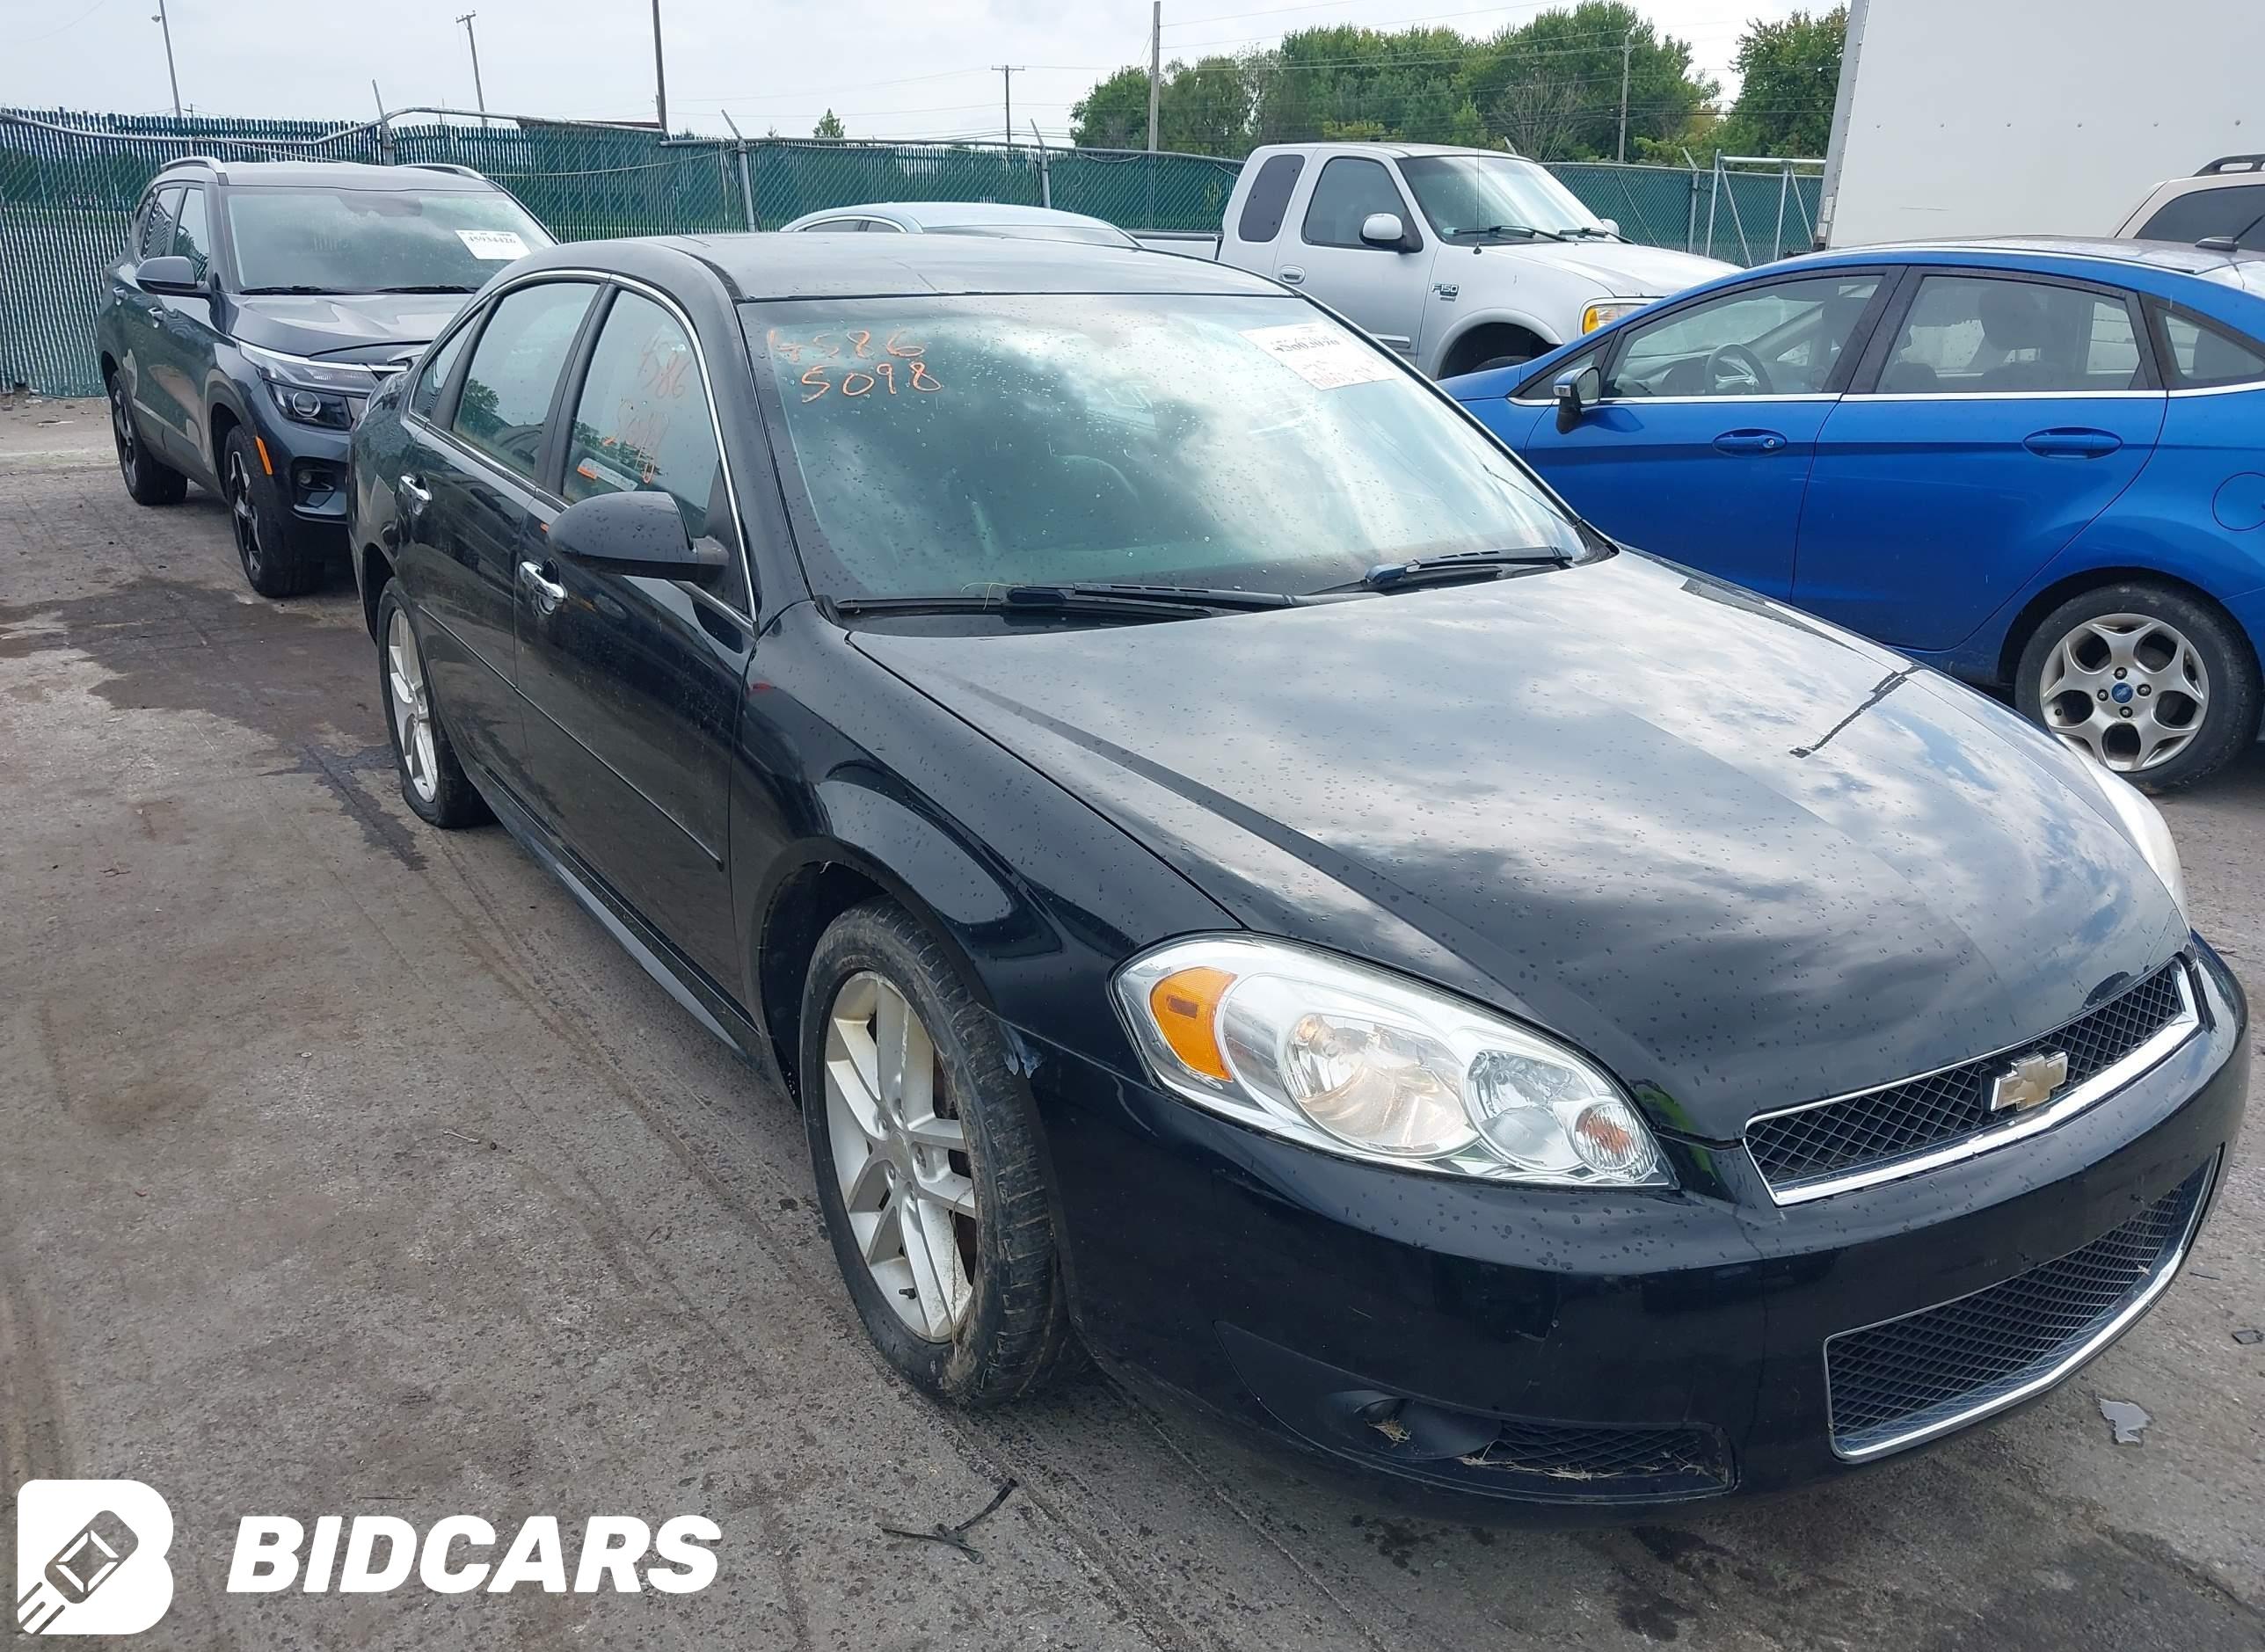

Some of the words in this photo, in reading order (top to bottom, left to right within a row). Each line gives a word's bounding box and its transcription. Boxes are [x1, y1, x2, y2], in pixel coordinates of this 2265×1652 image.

[1431, 283, 1460, 294] F150
[767, 328, 925, 362] 4586
[801, 361, 943, 404] 5098
